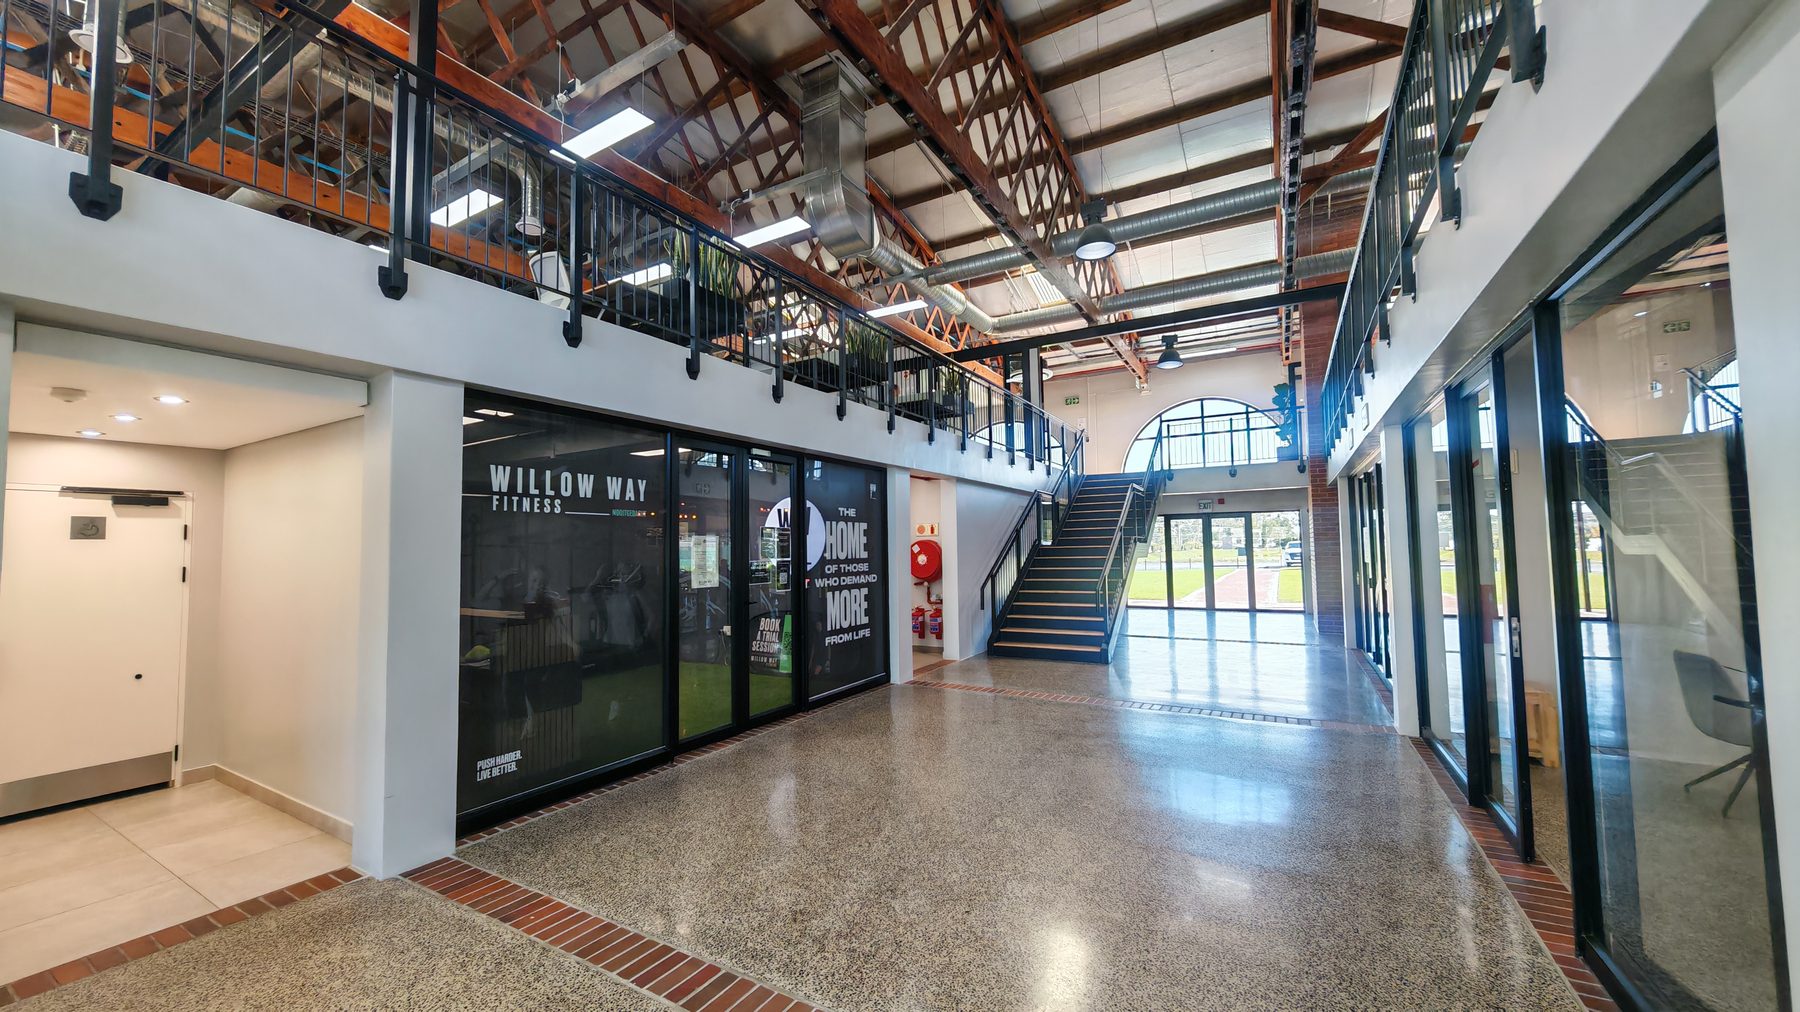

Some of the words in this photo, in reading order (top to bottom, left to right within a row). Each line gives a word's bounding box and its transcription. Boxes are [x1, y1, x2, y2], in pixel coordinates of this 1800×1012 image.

[490, 464, 594, 498] WILLOW
[606, 475, 647, 502] WAY
[492, 496, 562, 514] FITNESS
[838, 507, 857, 517] THE
[825, 521, 869, 560] HOME
[825, 564, 839, 574] OF
[840, 563, 869, 573] THOSE
[815, 577, 839, 588] WHO
[840, 574, 878, 585] DEMAND
[826, 587, 869, 632] MORE
[760, 617, 781, 631] BOOK
[756, 630, 761, 641] A
[762, 631, 779, 642] TRIAL
[825, 632, 853, 646] FROM
[854, 628, 871, 640] LIFE
[752, 641, 779, 653] SESSION
[477, 757, 496, 771] PUSH
[496, 750, 522, 766] HARDER.
[477, 767, 492, 782] LIVE
[492, 762, 518, 776] BETTER.
